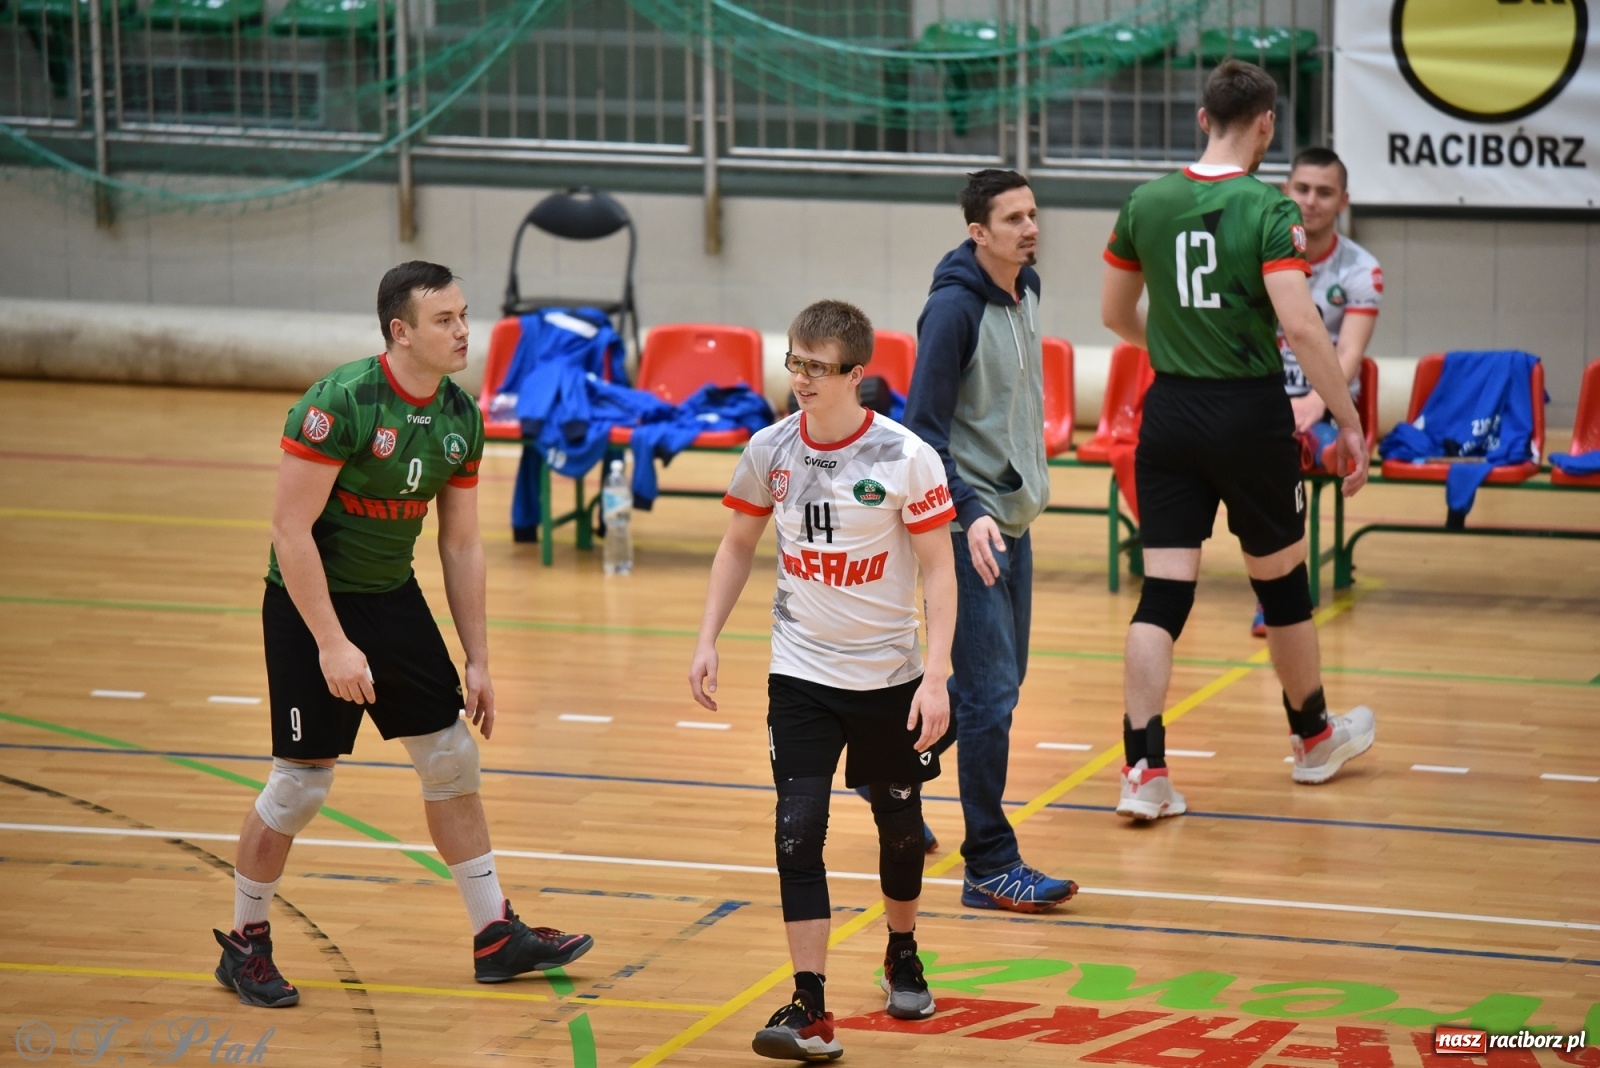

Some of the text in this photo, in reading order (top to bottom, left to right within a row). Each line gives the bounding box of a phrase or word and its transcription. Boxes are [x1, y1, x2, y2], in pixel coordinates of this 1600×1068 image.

[1388, 126, 1587, 168] RACIBÓRZ
[1175, 230, 1221, 309] 12
[399, 457, 422, 494] 9
[805, 501, 834, 544] 14
[290, 707, 302, 742] 9
